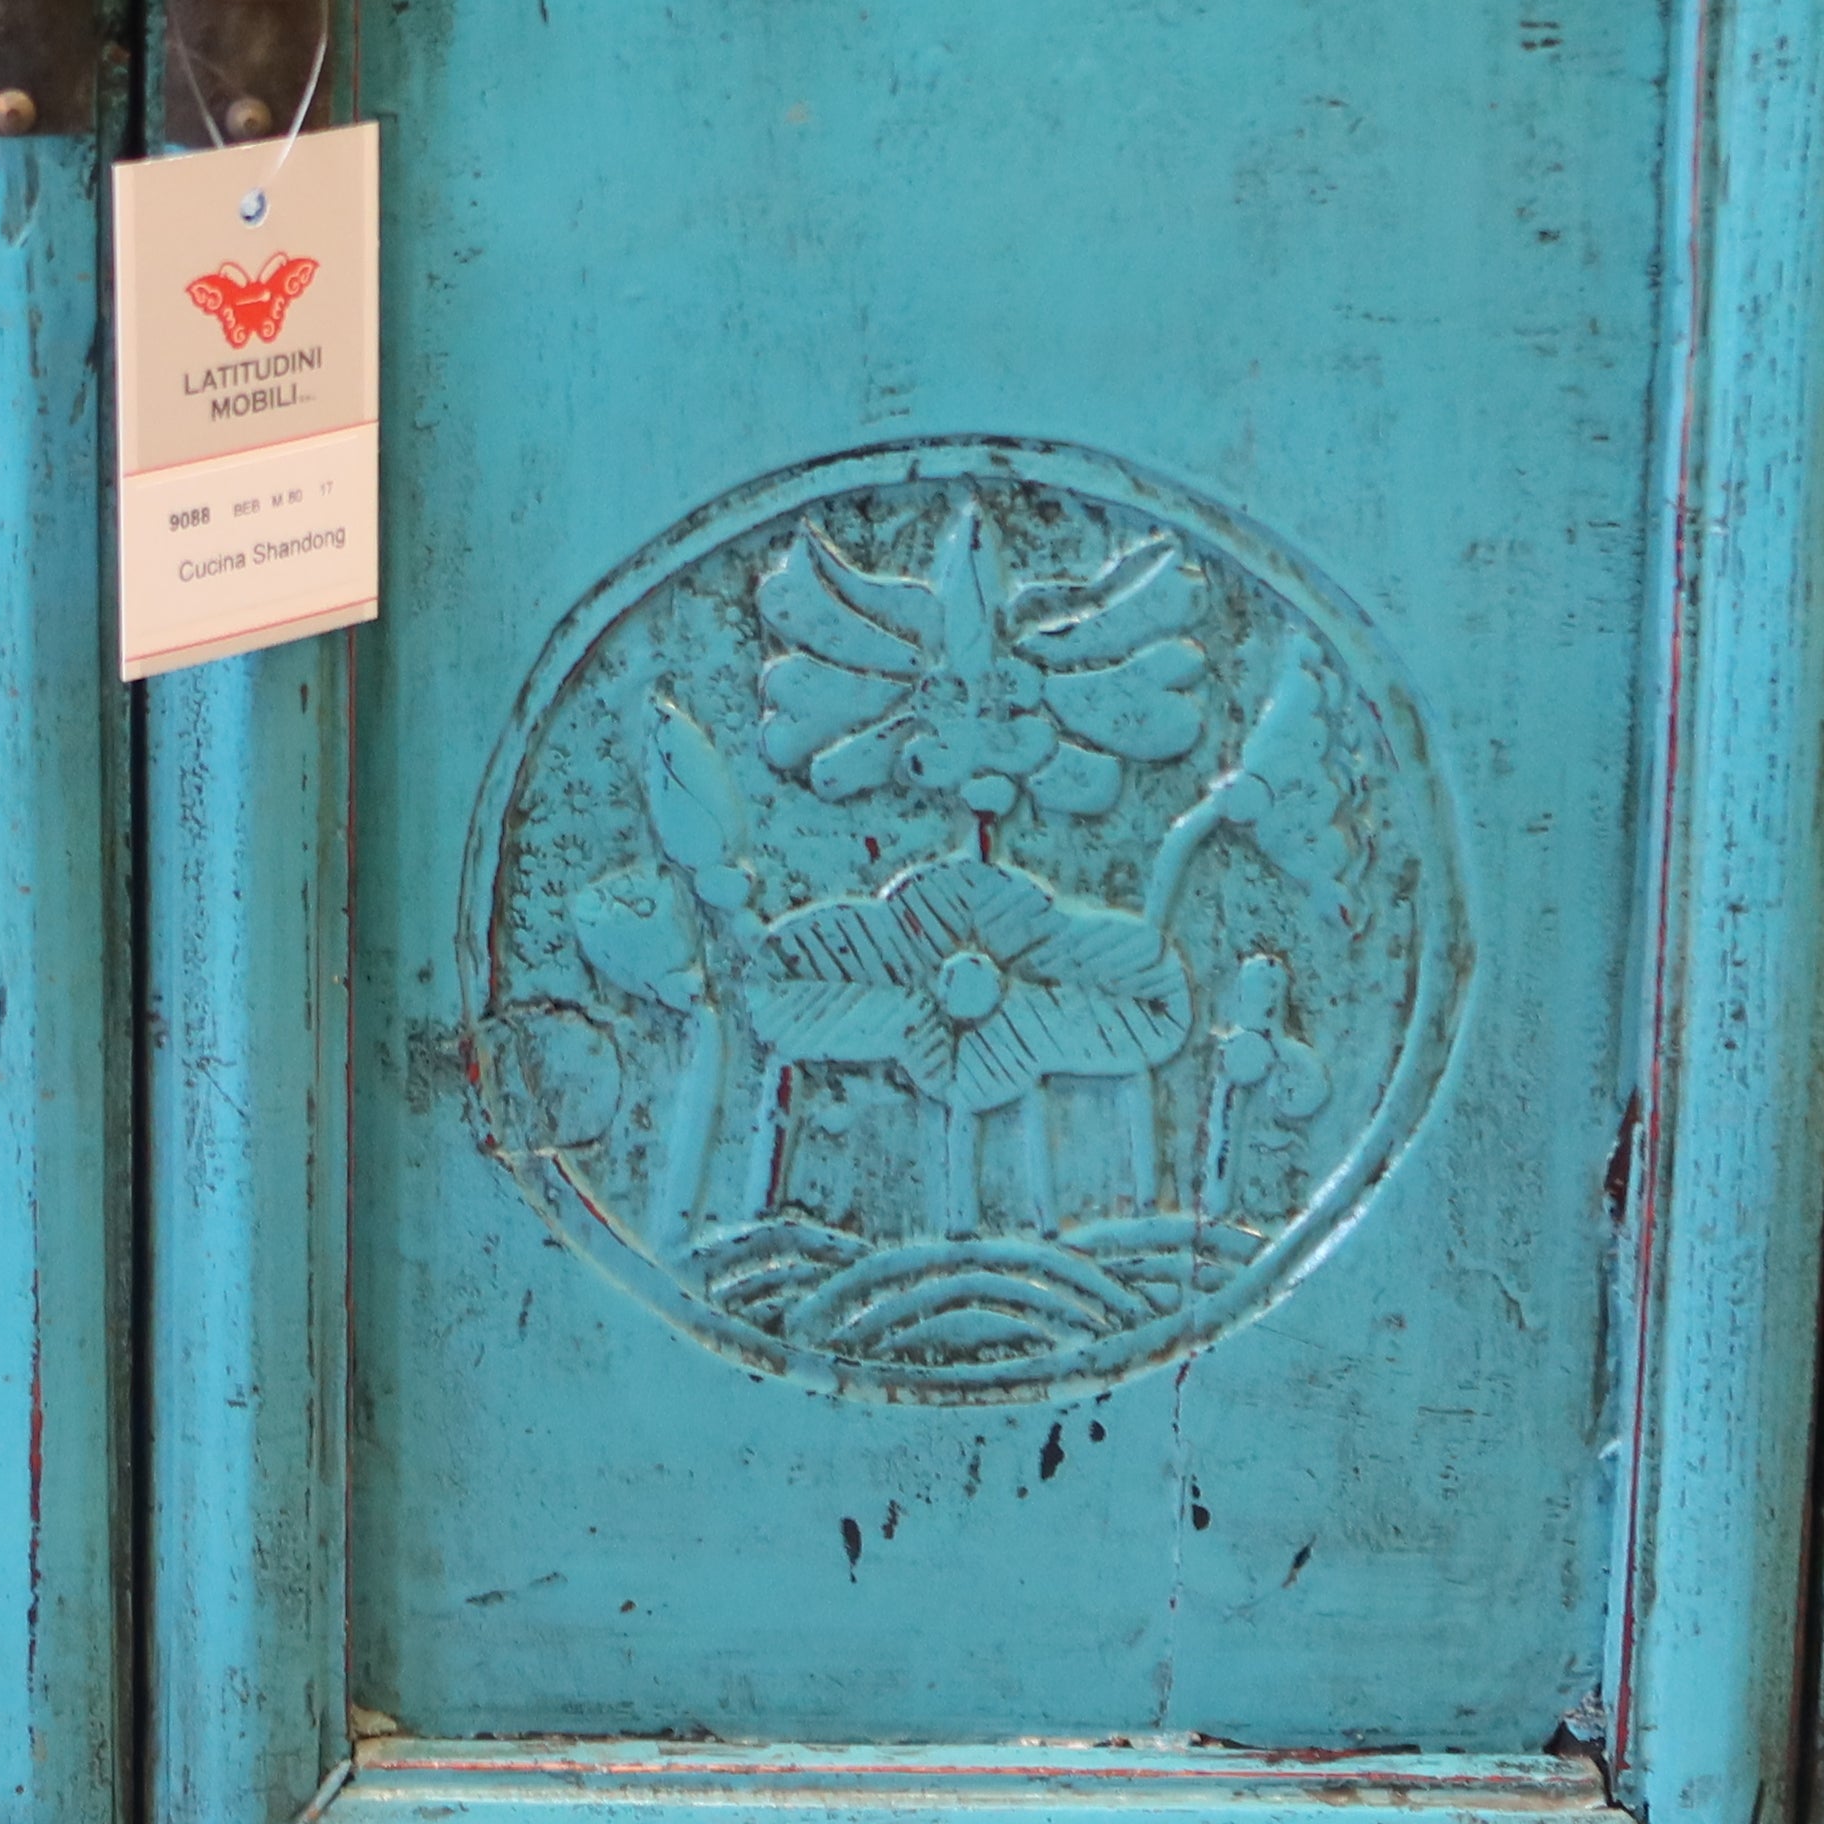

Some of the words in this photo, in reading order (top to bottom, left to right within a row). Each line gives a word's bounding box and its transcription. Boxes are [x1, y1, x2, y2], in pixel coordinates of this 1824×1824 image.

[184, 346, 322, 395] LATITUDINI
[211, 382, 297, 422] MOBILI
[169, 506, 210, 532] 9088
[179, 552, 246, 582] Cucina
[253, 526, 346, 565] Shandong
